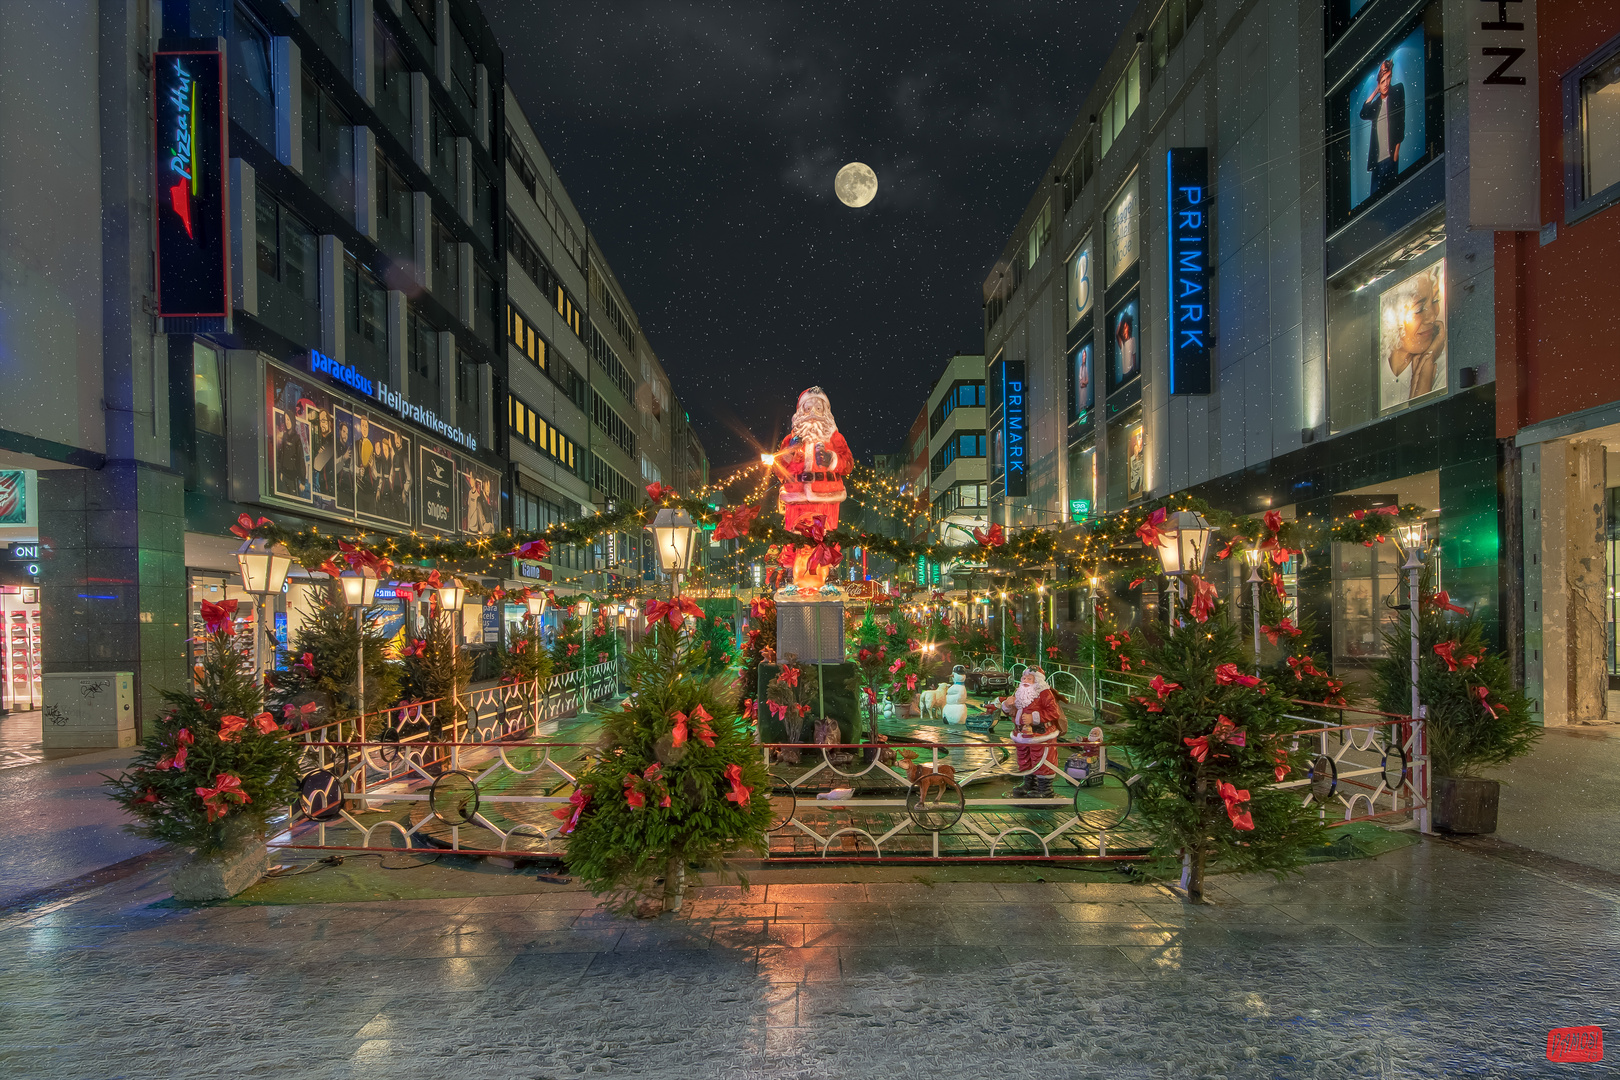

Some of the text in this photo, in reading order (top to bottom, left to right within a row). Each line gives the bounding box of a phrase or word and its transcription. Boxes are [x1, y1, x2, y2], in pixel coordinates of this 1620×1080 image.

[169, 58, 191, 179] Pizza Hut
[1075, 250, 1090, 313] 3
[1112, 239, 1133, 269] Mode
[1178, 186, 1204, 350] PRIMARK
[311, 348, 477, 452] paracelsus Heilpraktikerschule
[1008, 380, 1023, 473] PRIMARK
[427, 501, 446, 521] snipes
[482, 612, 495, 620] cels
